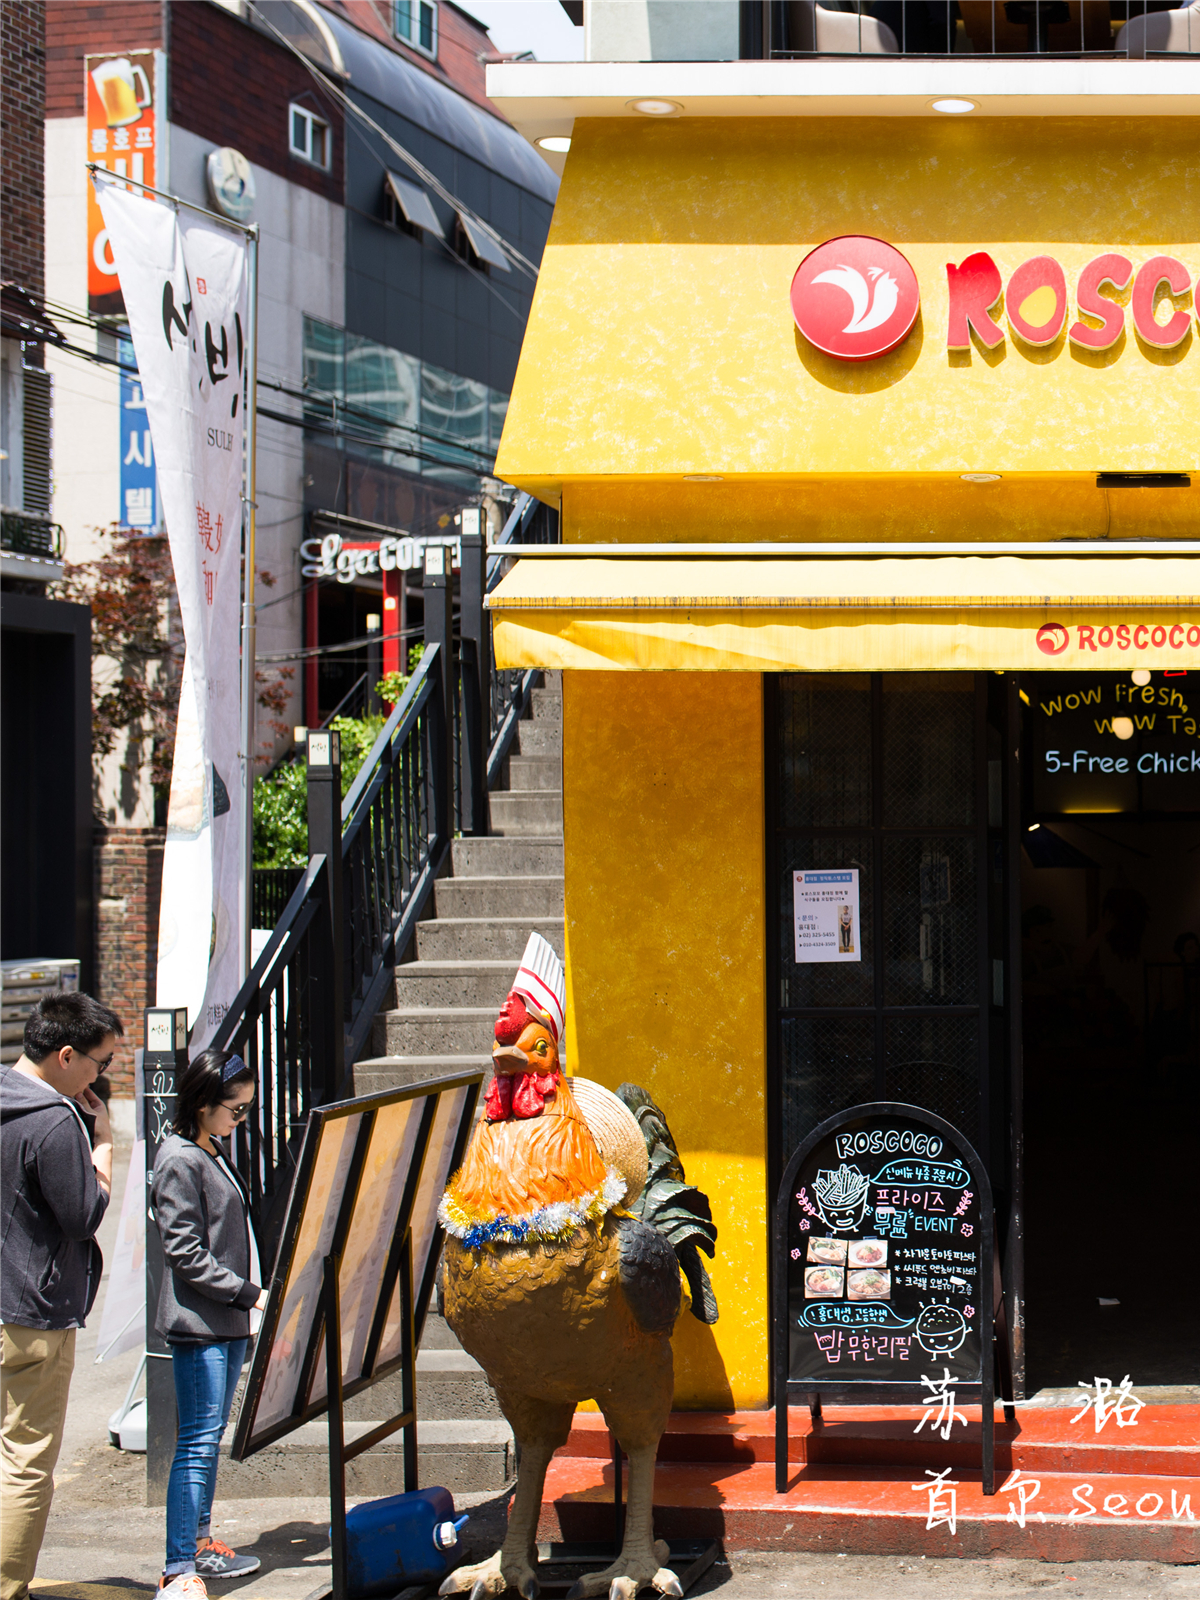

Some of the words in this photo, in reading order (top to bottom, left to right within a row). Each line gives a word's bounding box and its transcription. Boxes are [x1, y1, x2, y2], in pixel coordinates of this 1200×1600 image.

[1045, 749, 1130, 774] 5-Free
[836, 1130, 943, 1159] ROSCOCO
[885, 1167, 913, 1181] 신메뉴
[915, 1165, 930, 1182] 4종
[876, 1189, 946, 1213] 프라이즈
[873, 1210, 908, 1239] 무료
[914, 1217, 958, 1234] EVENT
[814, 1330, 845, 1363] 밥
[847, 1335, 912, 1361] 무한리필
